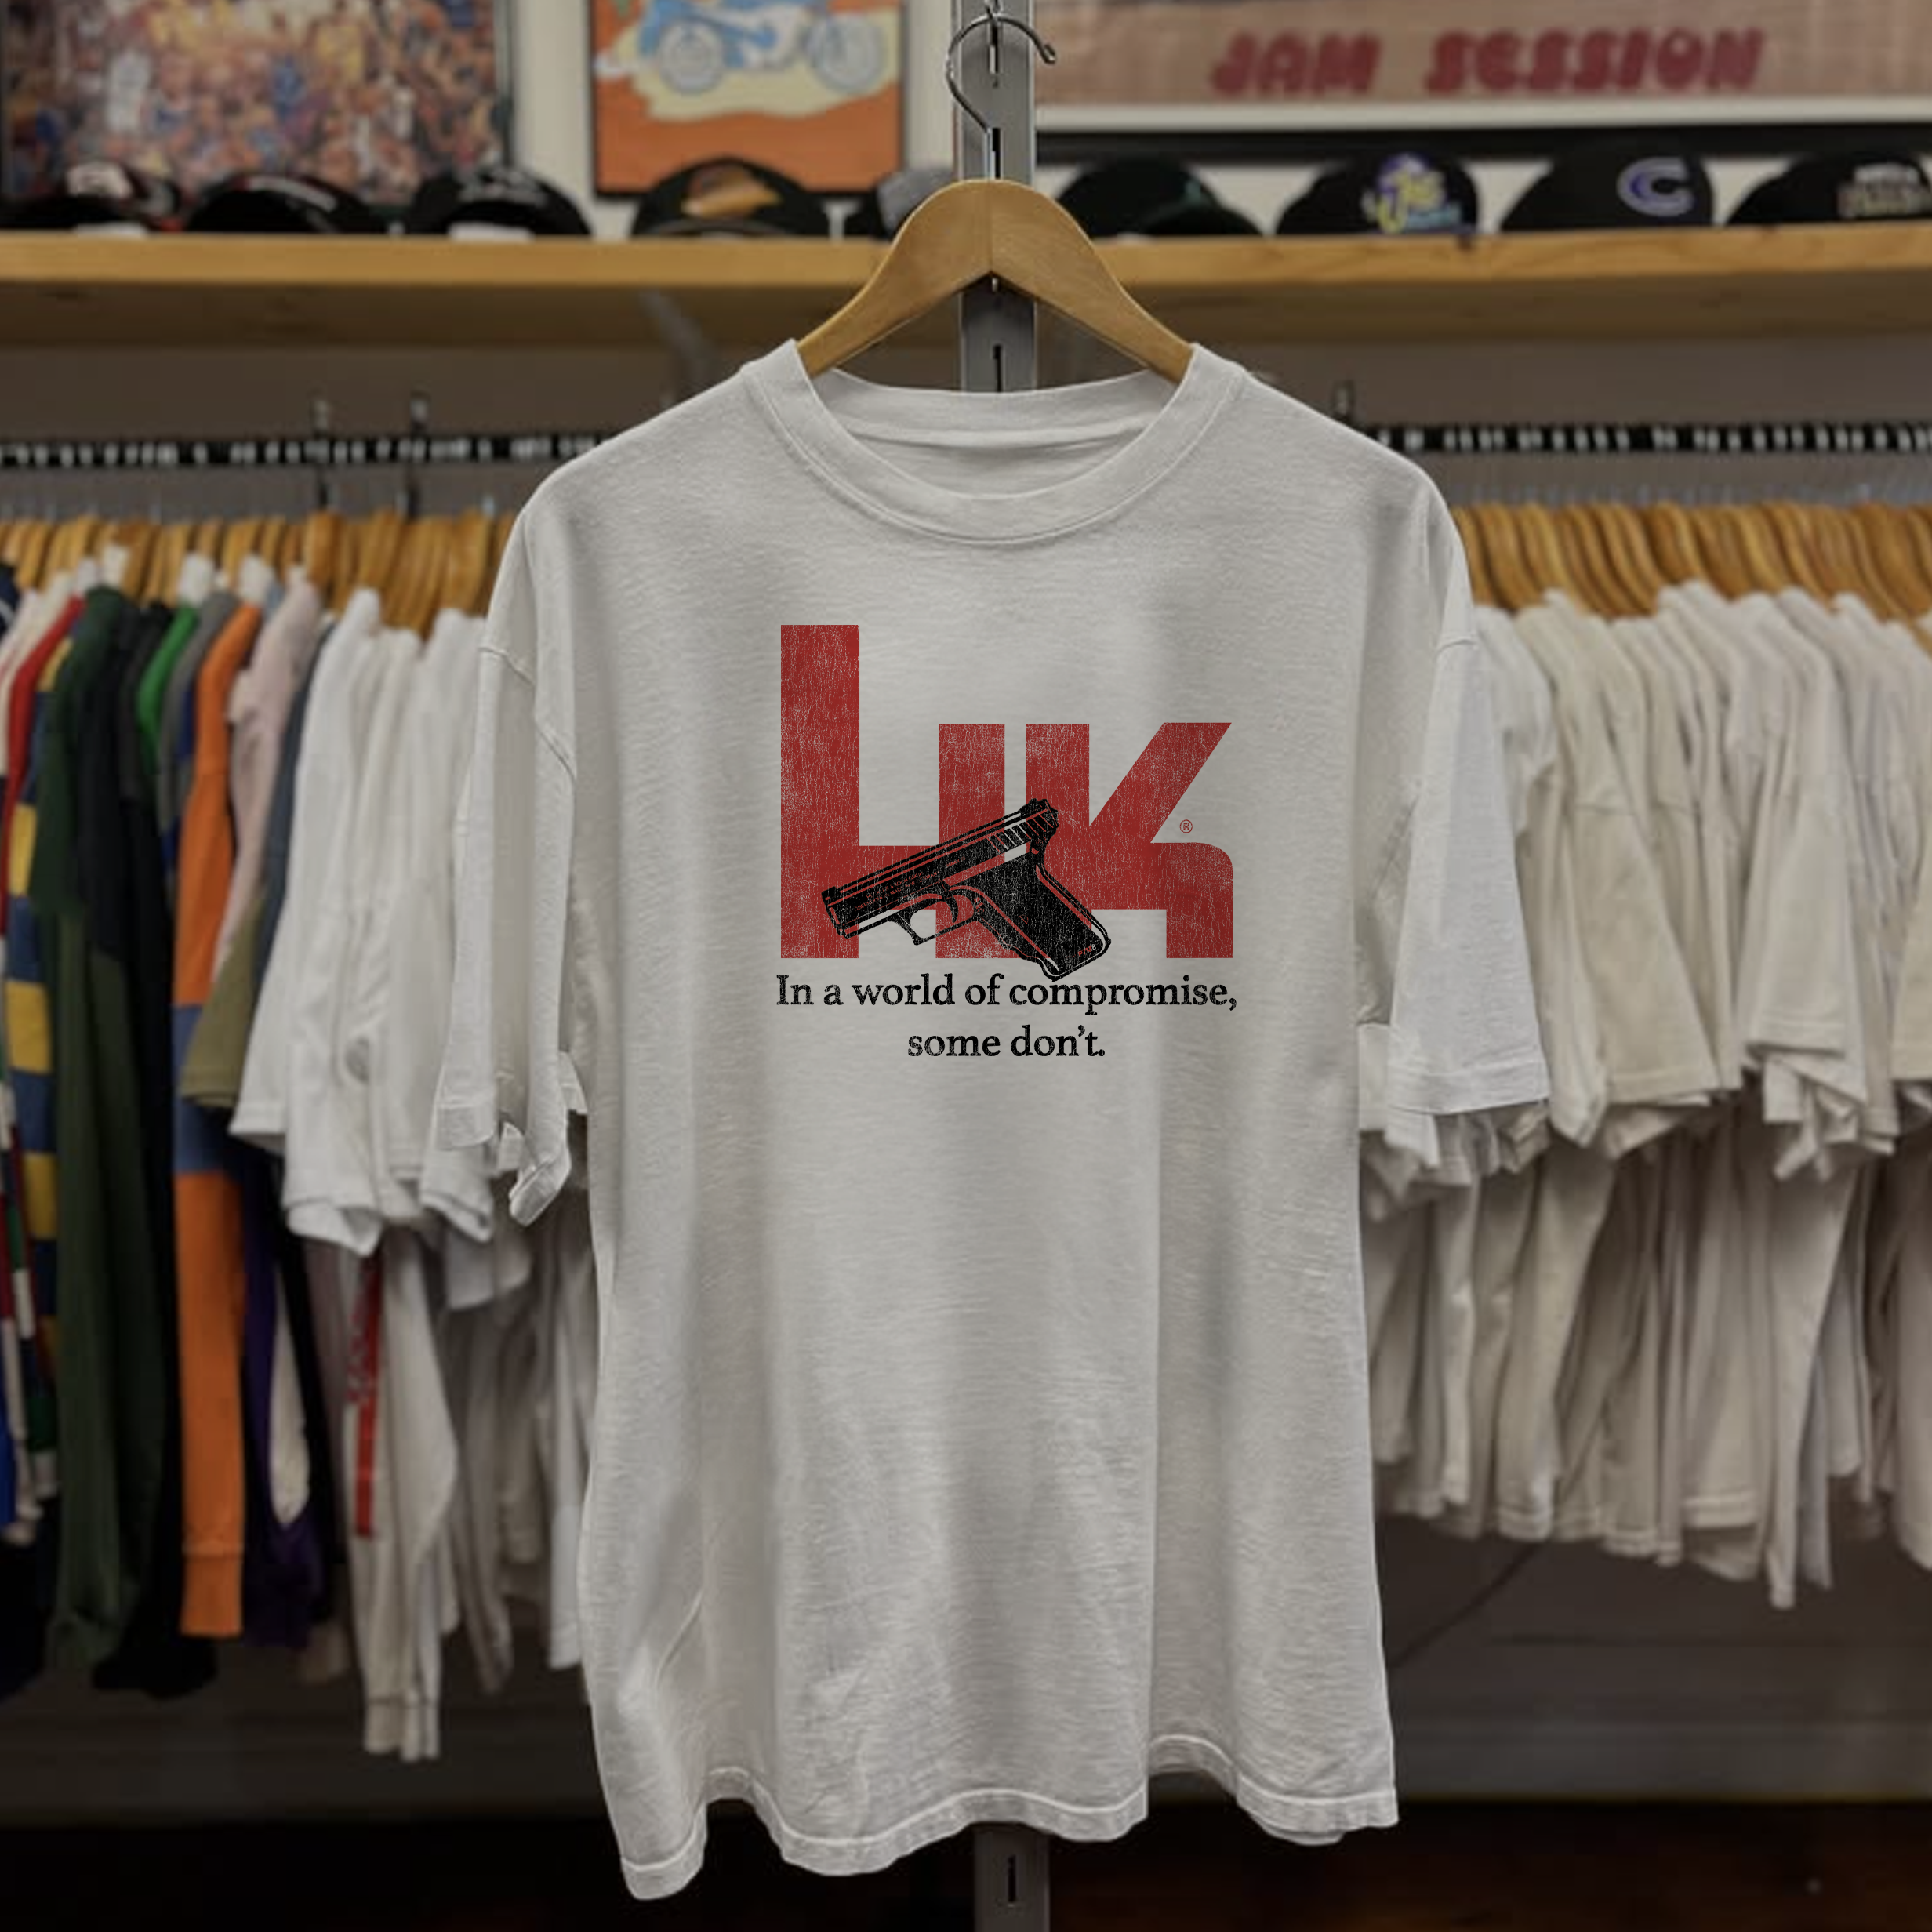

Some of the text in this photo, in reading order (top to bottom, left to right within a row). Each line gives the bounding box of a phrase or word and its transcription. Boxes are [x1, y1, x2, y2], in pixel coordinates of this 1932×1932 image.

[1211, 28, 1764, 96] JAM SESSION
[776, 972, 1237, 1015] In a world of compromise,
[908, 1035, 1000, 1057] some
